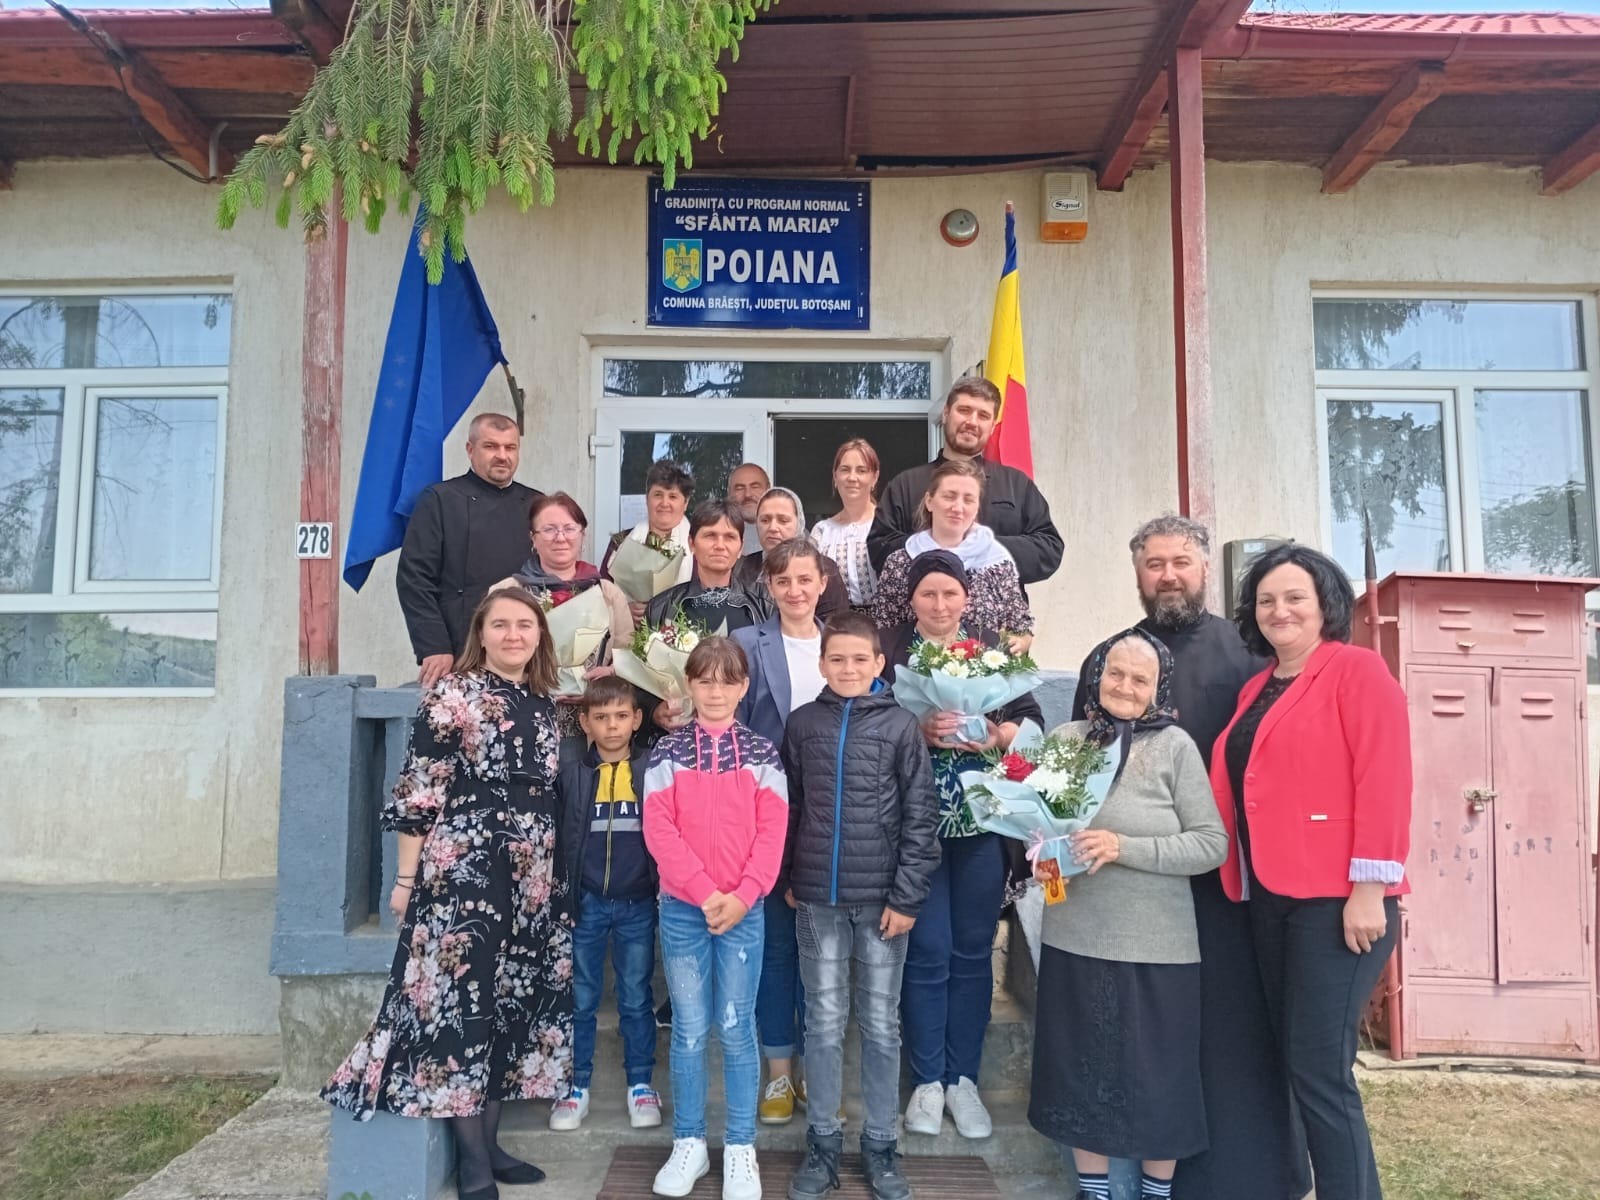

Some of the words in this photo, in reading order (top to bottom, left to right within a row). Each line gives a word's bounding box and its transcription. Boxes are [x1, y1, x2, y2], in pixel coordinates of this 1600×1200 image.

[728, 198, 744, 209] CU
[747, 198, 801, 211] PROGRAM
[804, 200, 851, 212] NORMAL
[1055, 200, 1080, 209] Signal
[706, 249, 840, 284] POIANA
[663, 296, 705, 309] COMUNA
[708, 295, 753, 312] BRĂEȘTI,
[755, 298, 800, 314] JUDEȚUL
[802, 299, 851, 314] BOTOȘANI
[298, 526, 330, 554] 278
